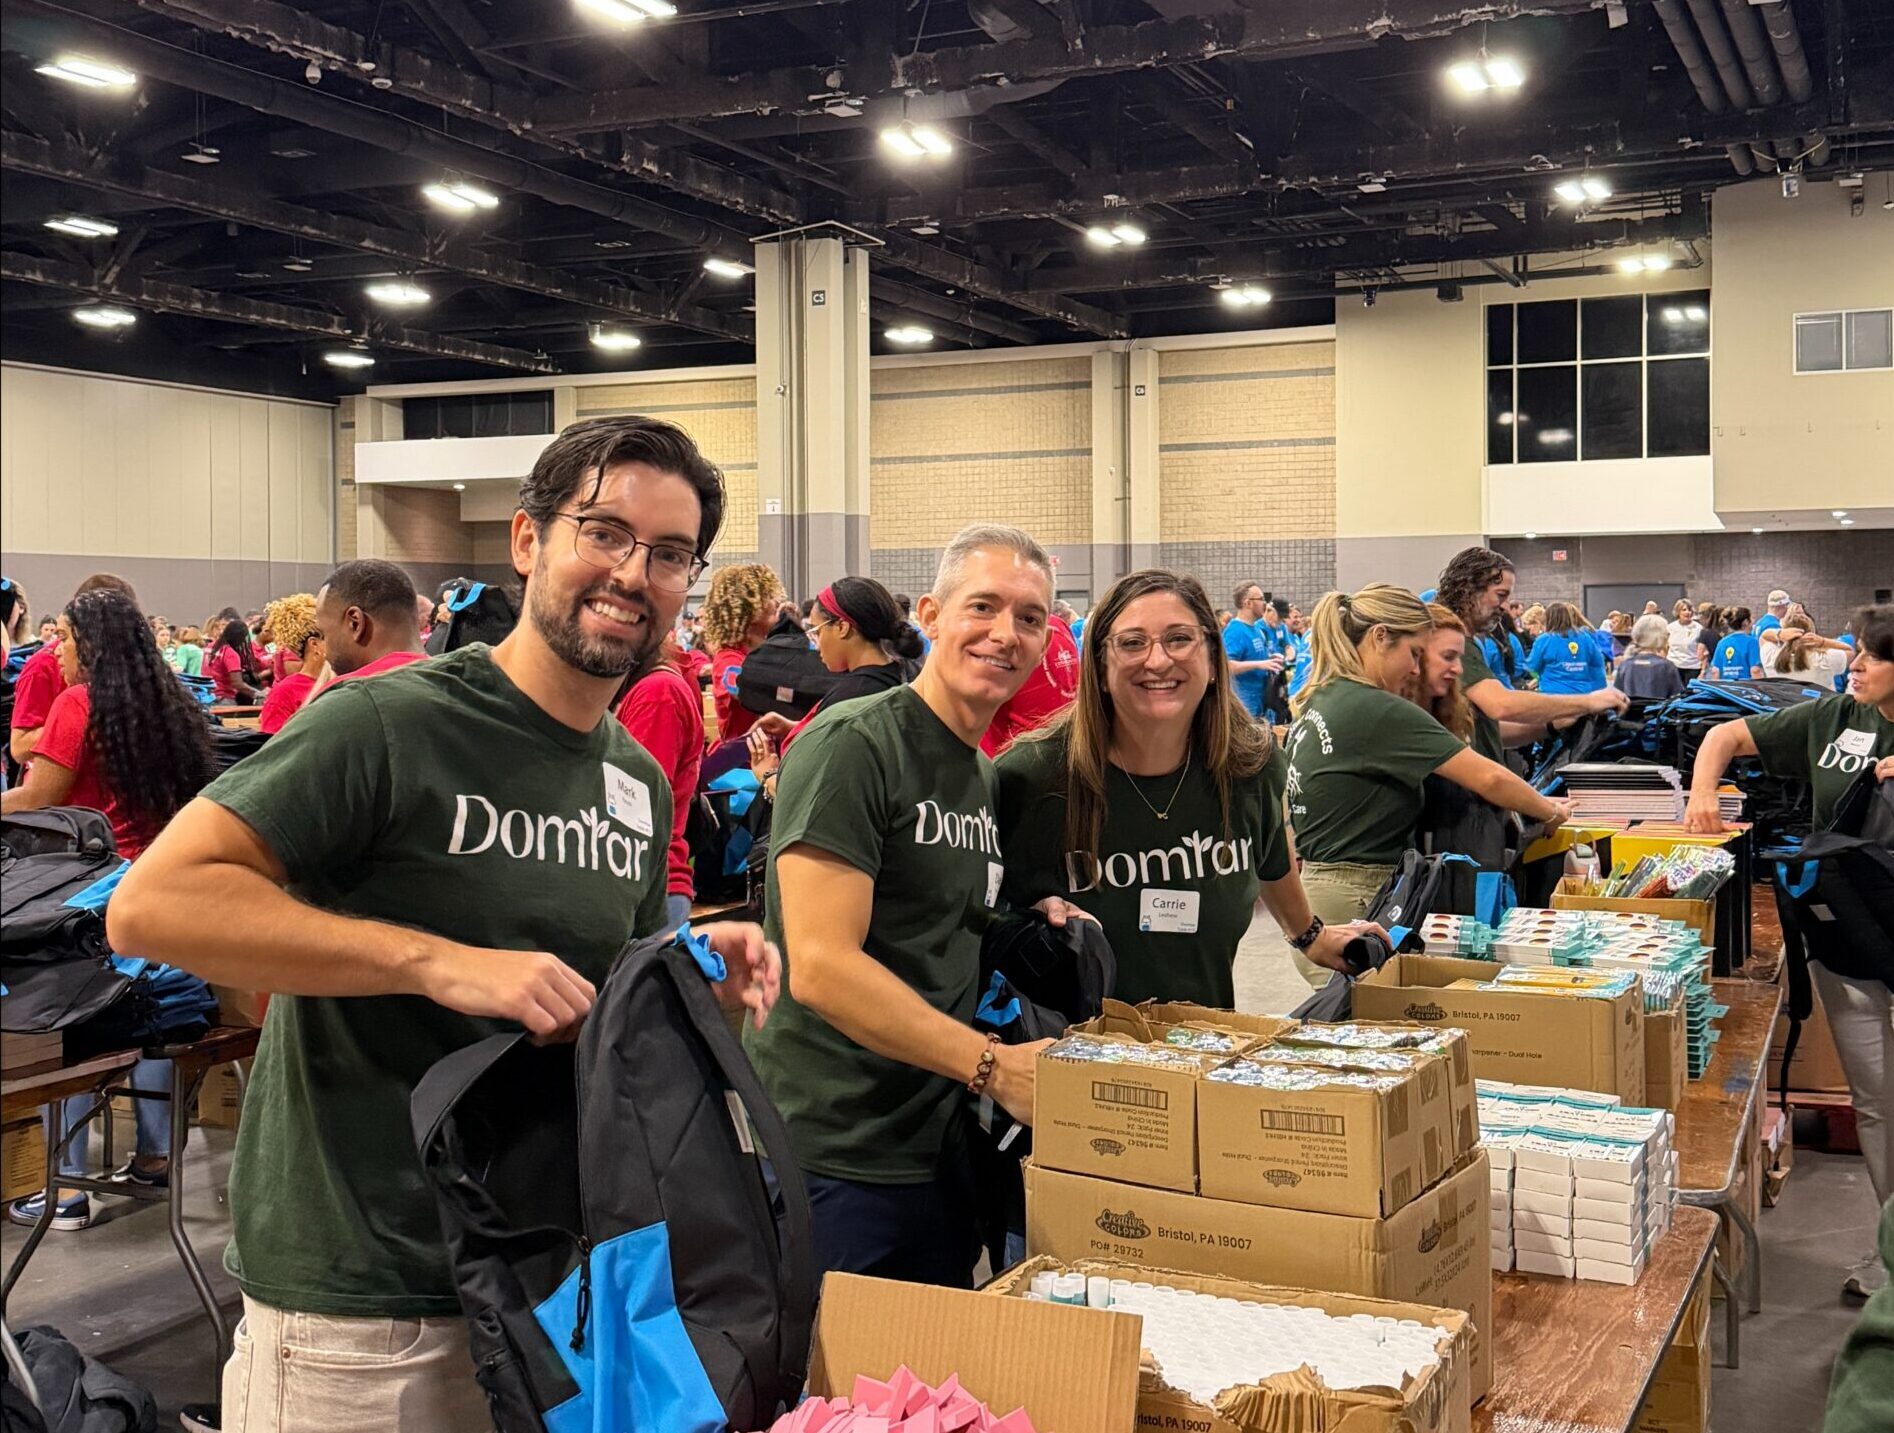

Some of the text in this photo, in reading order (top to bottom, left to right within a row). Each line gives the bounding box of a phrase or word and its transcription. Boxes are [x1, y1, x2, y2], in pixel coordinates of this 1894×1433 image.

[1304, 708, 1334, 755] connects
[617, 778, 637, 800] Mark
[447, 795, 649, 882] Domtar
[1065, 829, 1252, 894] Domtar
[1152, 898, 1186, 910] Carrie
[1452, 1010, 1482, 1020] Bristol,
[1496, 1013, 1521, 1022] 19007
[1127, 1116, 1144, 1124] China
[1102, 1209, 1143, 1228] Creative
[1104, 1224, 1142, 1237] COLORS
[1158, 1226, 1252, 1250] Bristol, PA 19007
[1090, 1240, 1144, 1258] PO# 29732
[1137, 1413, 1212, 1433] ristol, PA 19007
